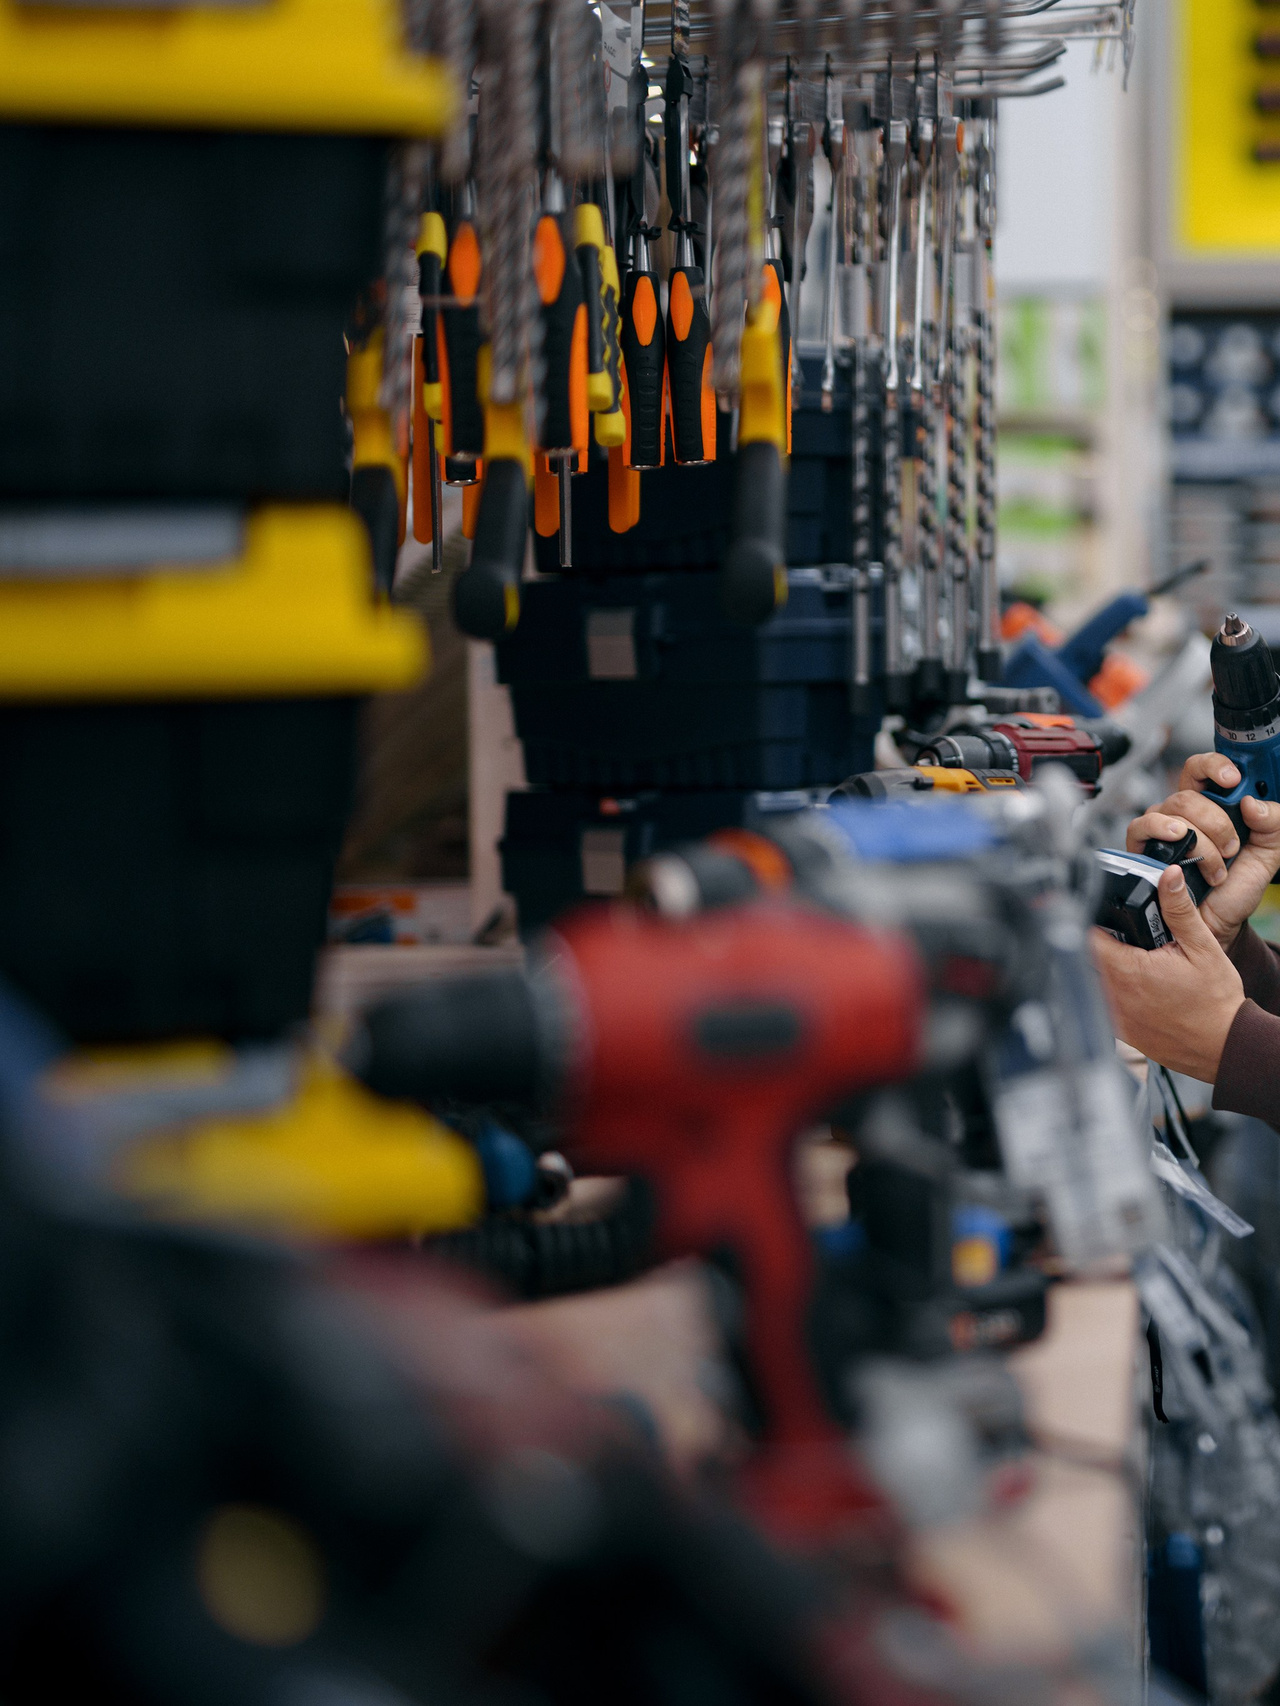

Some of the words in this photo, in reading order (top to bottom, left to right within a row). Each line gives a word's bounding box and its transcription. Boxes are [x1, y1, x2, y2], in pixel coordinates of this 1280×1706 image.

[1228, 731, 1238, 741] 10
[1246, 733, 1257, 741] 12
[1266, 726, 1275, 736] 14
